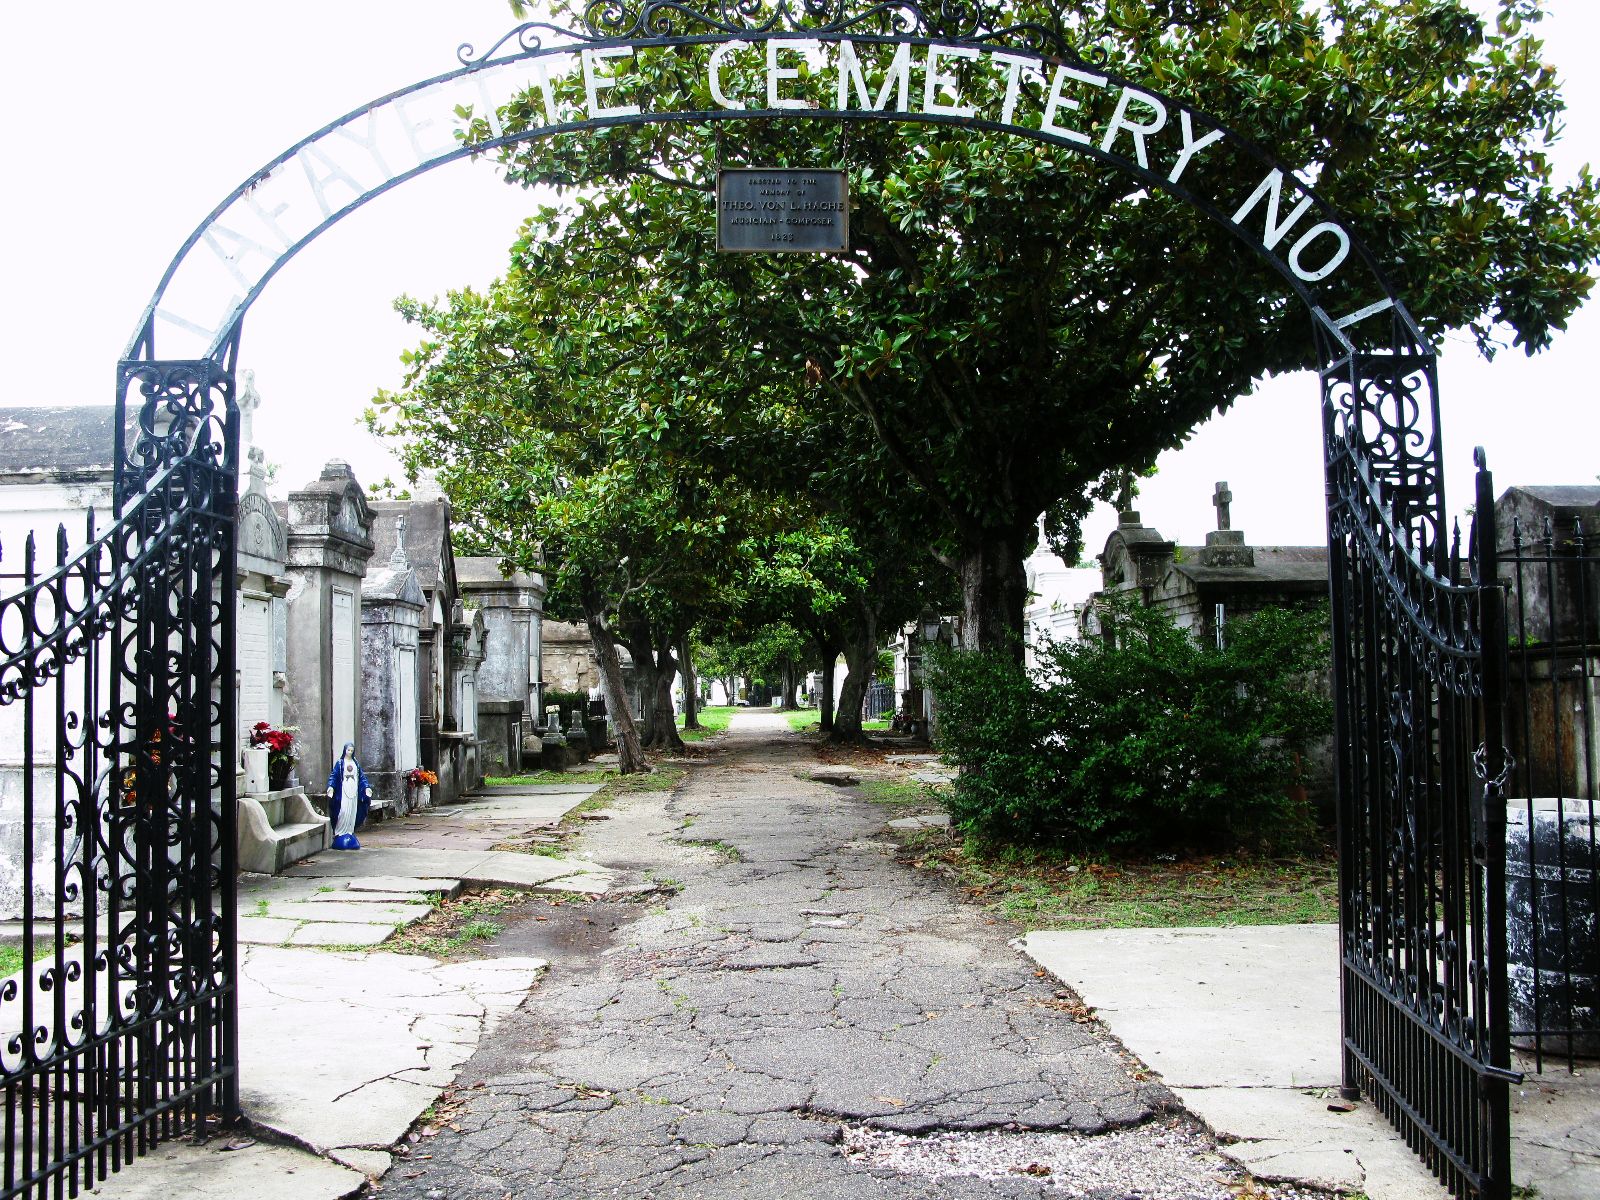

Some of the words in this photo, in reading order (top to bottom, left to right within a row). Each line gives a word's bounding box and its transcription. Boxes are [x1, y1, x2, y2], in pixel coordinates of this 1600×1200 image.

[153, 45, 642, 341] LAFAYETTE
[708, 38, 1225, 184] CEMETERY
[760, 201, 786, 211] VON
[803, 201, 845, 212] HACHE
